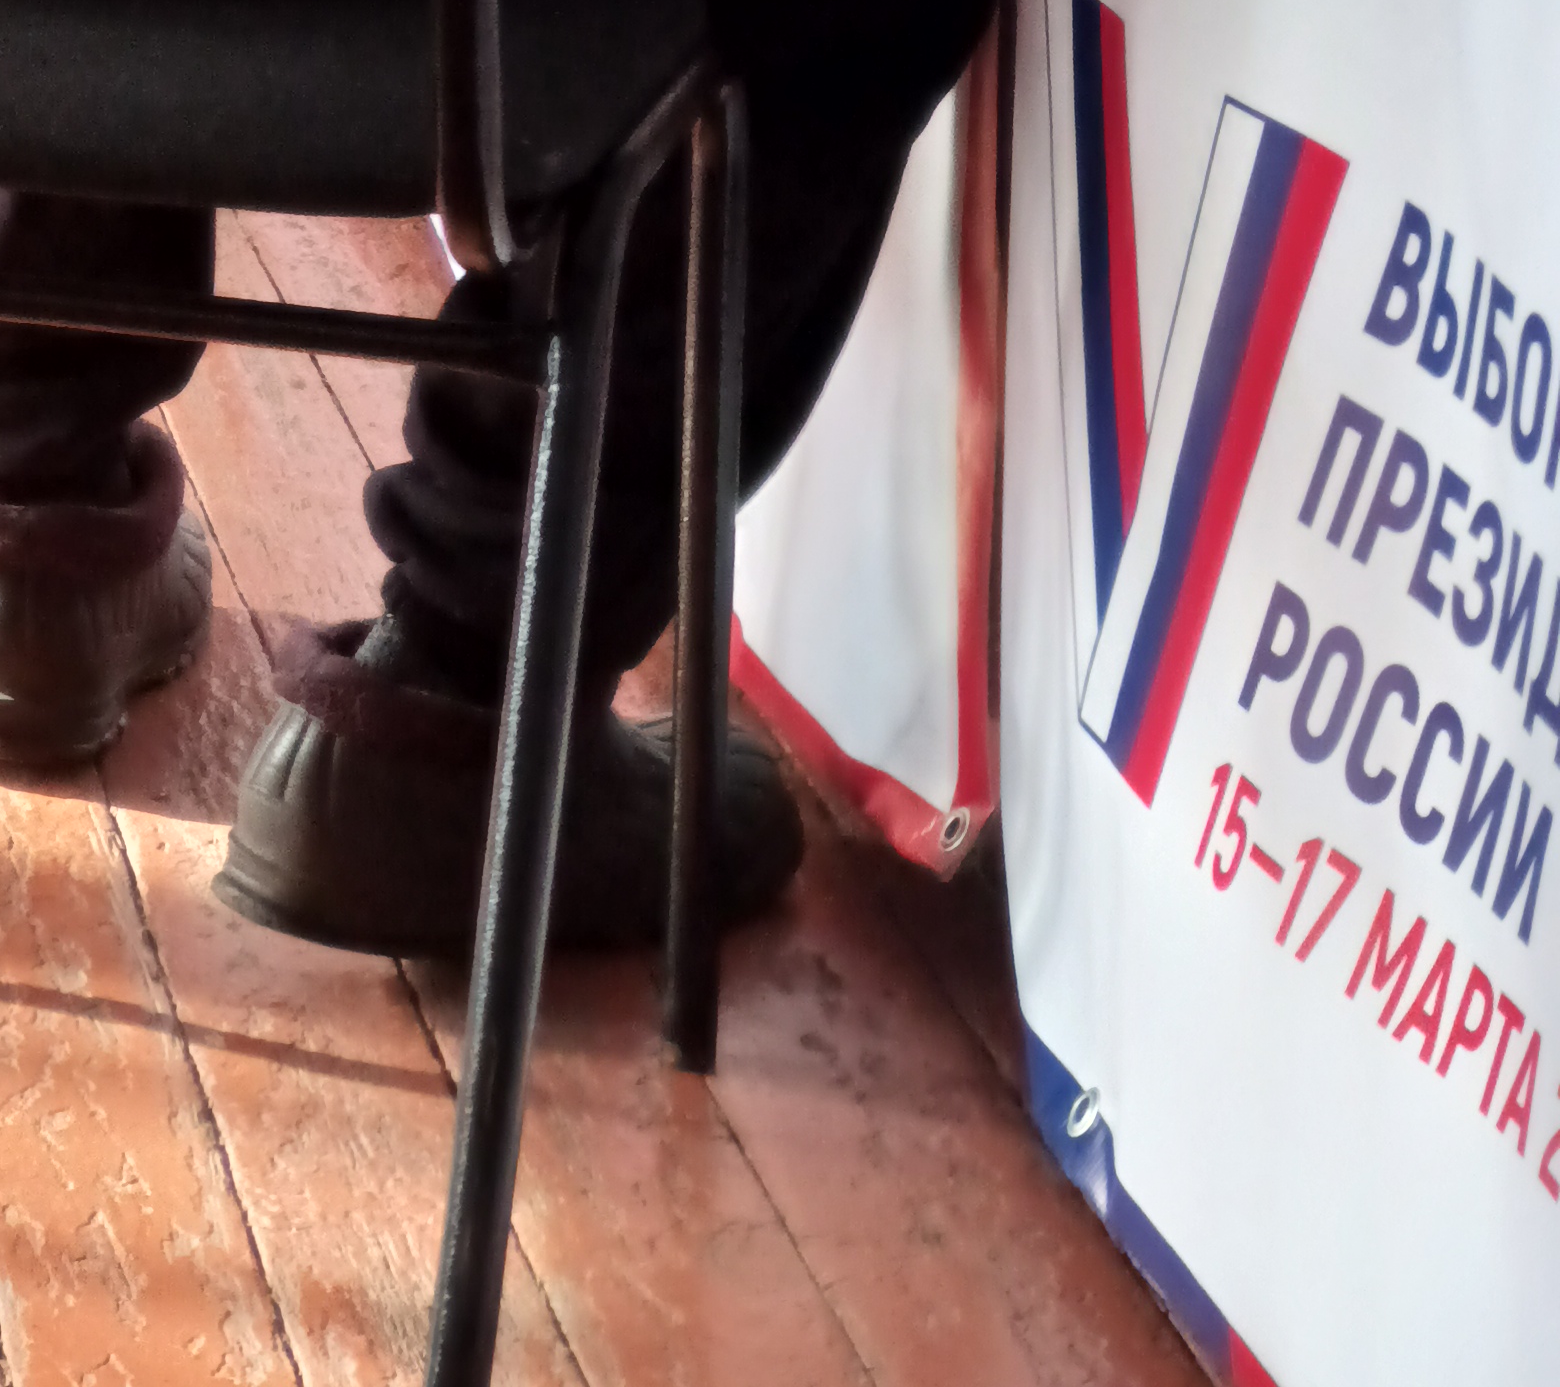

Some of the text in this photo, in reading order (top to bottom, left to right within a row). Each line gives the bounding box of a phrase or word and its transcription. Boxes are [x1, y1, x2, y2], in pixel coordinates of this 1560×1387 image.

[1363, 200, 1560, 489] ВЫБО
[1237, 581, 1554, 945] РОССИИ
[1345, 888, 1542, 1156] МАРТА
